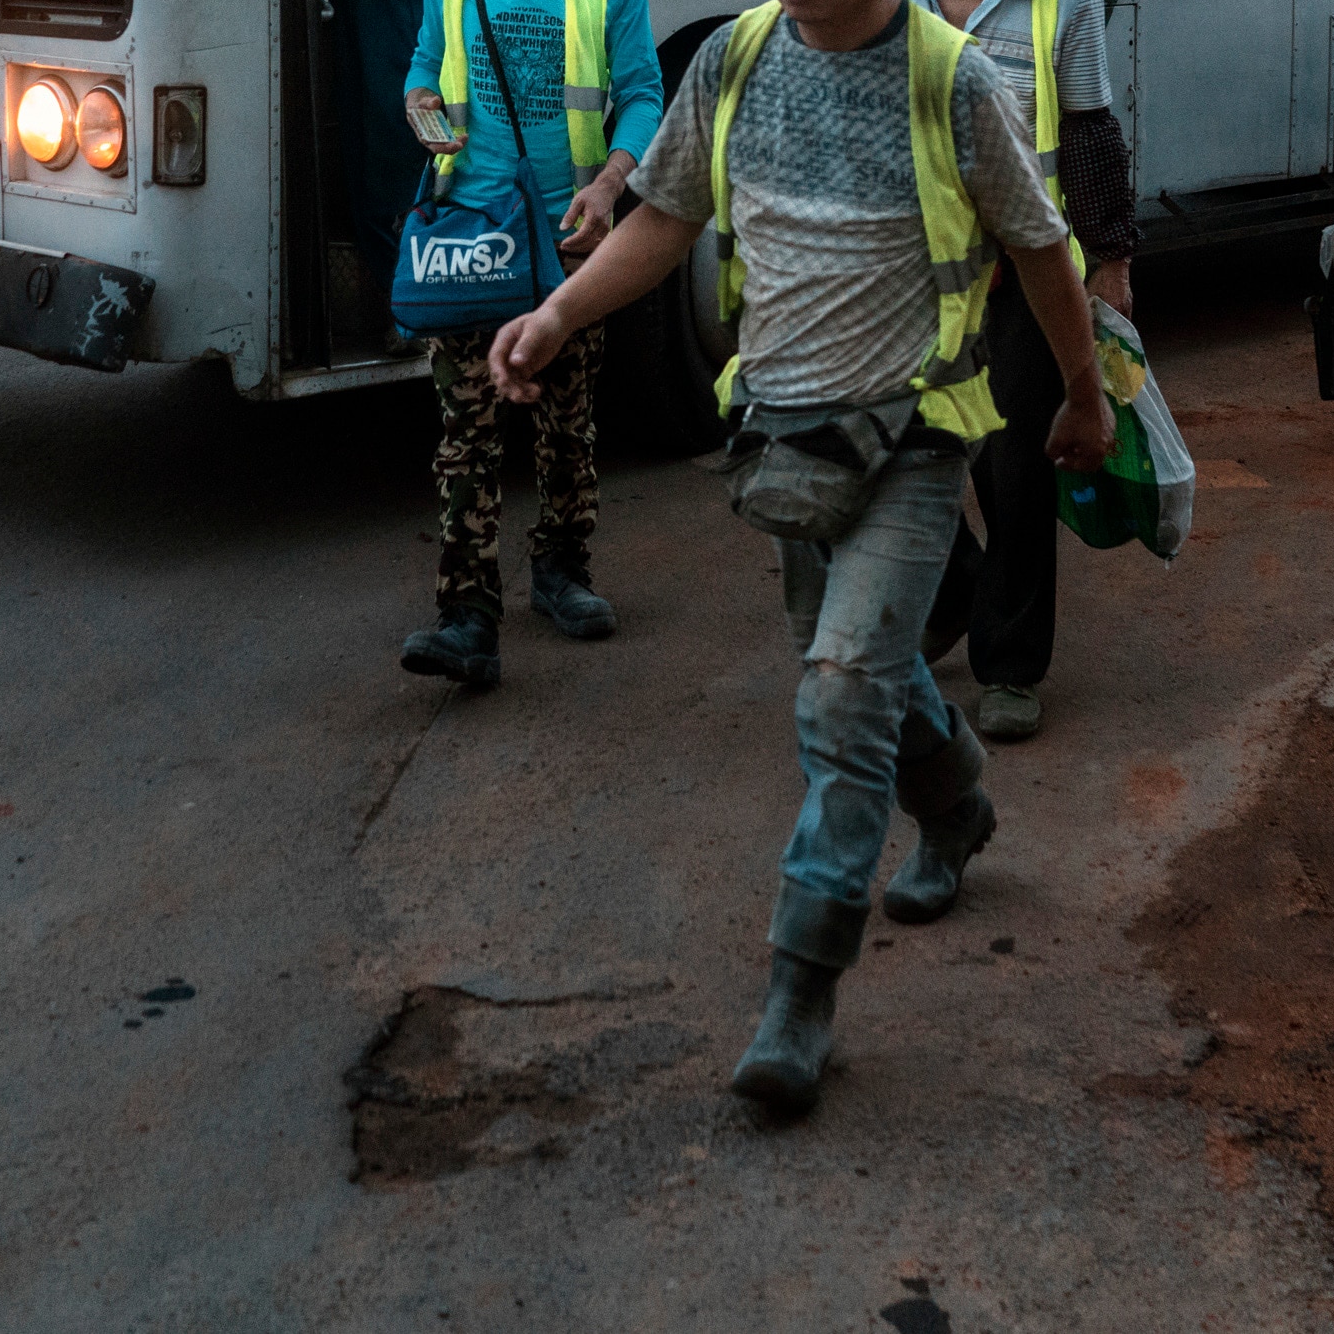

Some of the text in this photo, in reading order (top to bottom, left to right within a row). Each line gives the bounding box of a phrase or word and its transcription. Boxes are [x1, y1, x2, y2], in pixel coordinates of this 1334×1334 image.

[410, 232, 515, 283] VANS
[426, 272, 517, 284] OFF THE WALL
